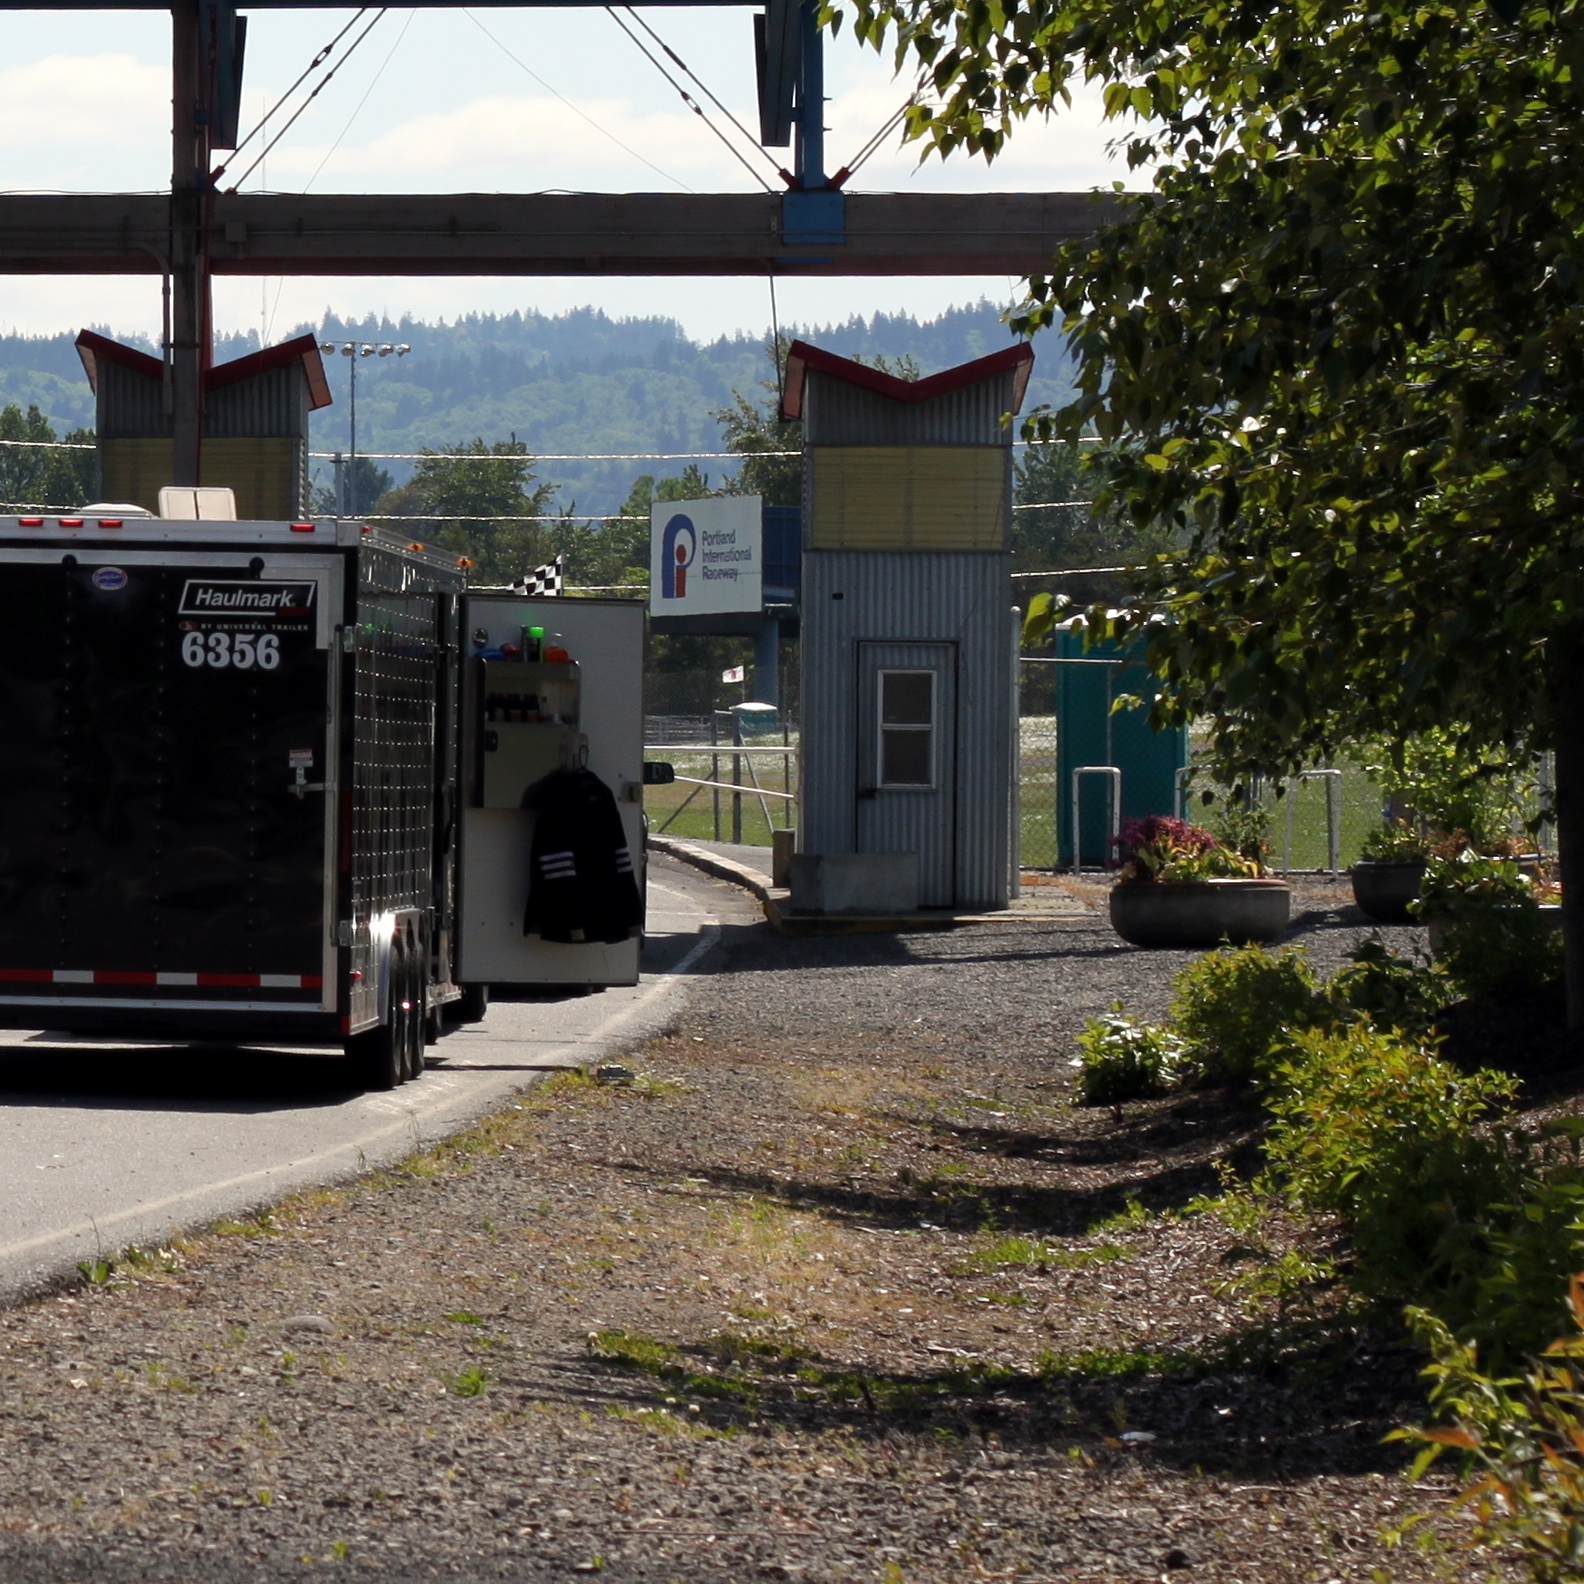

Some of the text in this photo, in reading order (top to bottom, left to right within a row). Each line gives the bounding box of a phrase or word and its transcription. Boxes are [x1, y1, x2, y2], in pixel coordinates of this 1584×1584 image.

[701, 529, 736, 546] Portland
[702, 546, 752, 563] International
[702, 565, 738, 582] Raceway
[194, 588, 293, 607] Haulmark
[216, 623, 267, 631] UNIVERSAL
[272, 624, 309, 632] TRAILER
[182, 631, 280, 669] 6356
